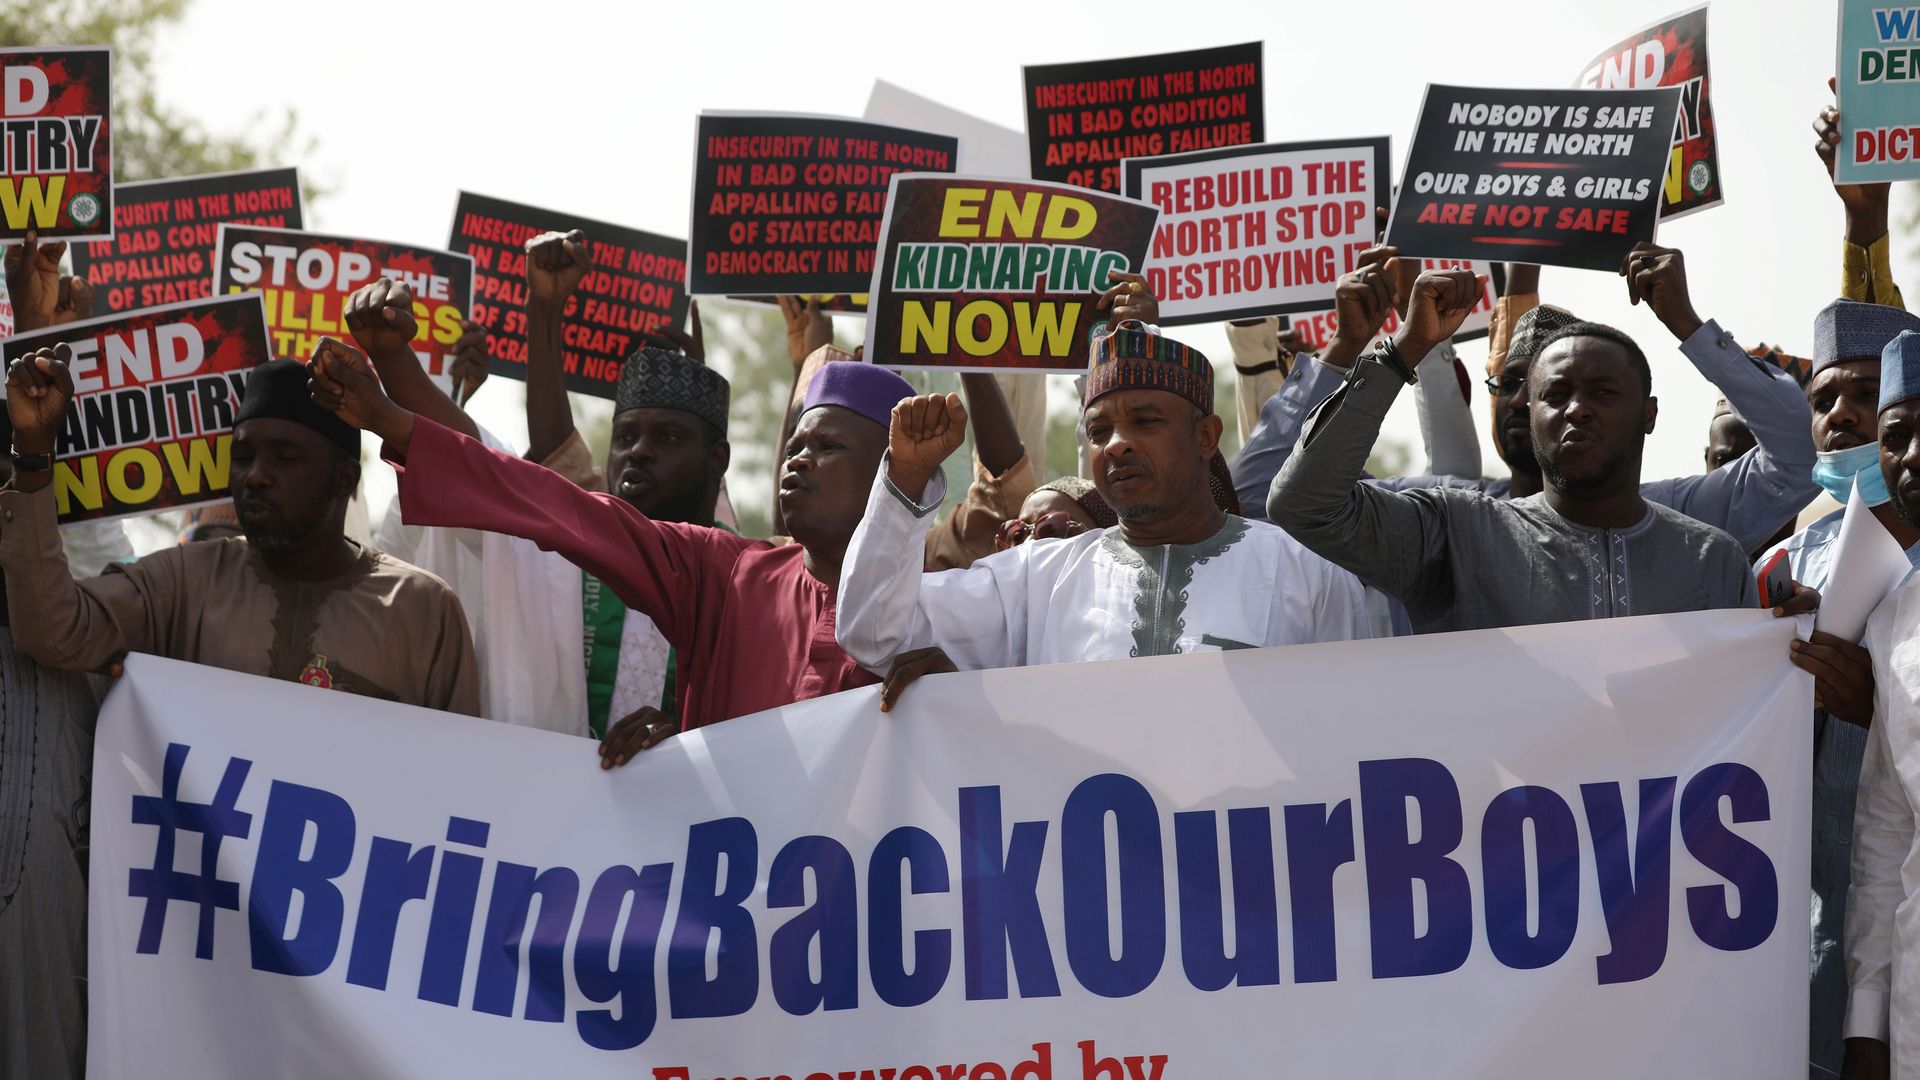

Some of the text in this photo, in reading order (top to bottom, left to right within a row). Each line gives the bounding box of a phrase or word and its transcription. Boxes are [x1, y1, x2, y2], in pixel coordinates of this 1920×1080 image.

[1036, 63, 1256, 109] INSECURITY IN THE NORTH
[1048, 93, 1247, 137] IN BAD CONDITION
[1448, 102, 1654, 129] NOBODY IS SAFE
[708, 136, 948, 170] INSECURITY IN THE NORTH
[1045, 121, 1252, 167] APPALLING FAILURE
[1454, 130, 1634, 156] IN THE NORTH
[716, 164, 743, 186] IN
[751, 163, 796, 185] BAD
[1152, 165, 1293, 215] REBUILD
[1302, 160, 1366, 196] THE
[1414, 171, 1651, 201] OUR BOYS & GIRLS
[175, 196, 195, 221] IN
[199, 193, 230, 217] THE
[233, 186, 293, 214] NORTH
[709, 191, 838, 215] APPALLING
[939, 187, 1098, 240] END
[1417, 203, 1632, 235] ARE NOT SAFE
[88, 240, 112, 258] IN
[118, 229, 160, 254] BAD
[729, 221, 759, 245] OF
[1153, 200, 1366, 260] NORTH STOP
[88, 251, 204, 286] APPALLING
[229, 241, 372, 291] STOP
[468, 243, 493, 269] IN
[498, 250, 526, 278] BA
[592, 241, 623, 270] THE
[628, 250, 686, 284] NORTH
[706, 251, 821, 274] DEMOCRACY
[828, 251, 848, 272] IN
[892, 242, 1130, 295] KIDNAPING
[1147, 246, 1335, 302] DESTROYING
[108, 287, 135, 311] OF
[473, 303, 499, 328] OF
[900, 300, 1083, 357] NOW
[69, 322, 205, 394] END
[54, 433, 233, 515] NOW
[128, 742, 1778, 1050] #BringBackOurBoys
